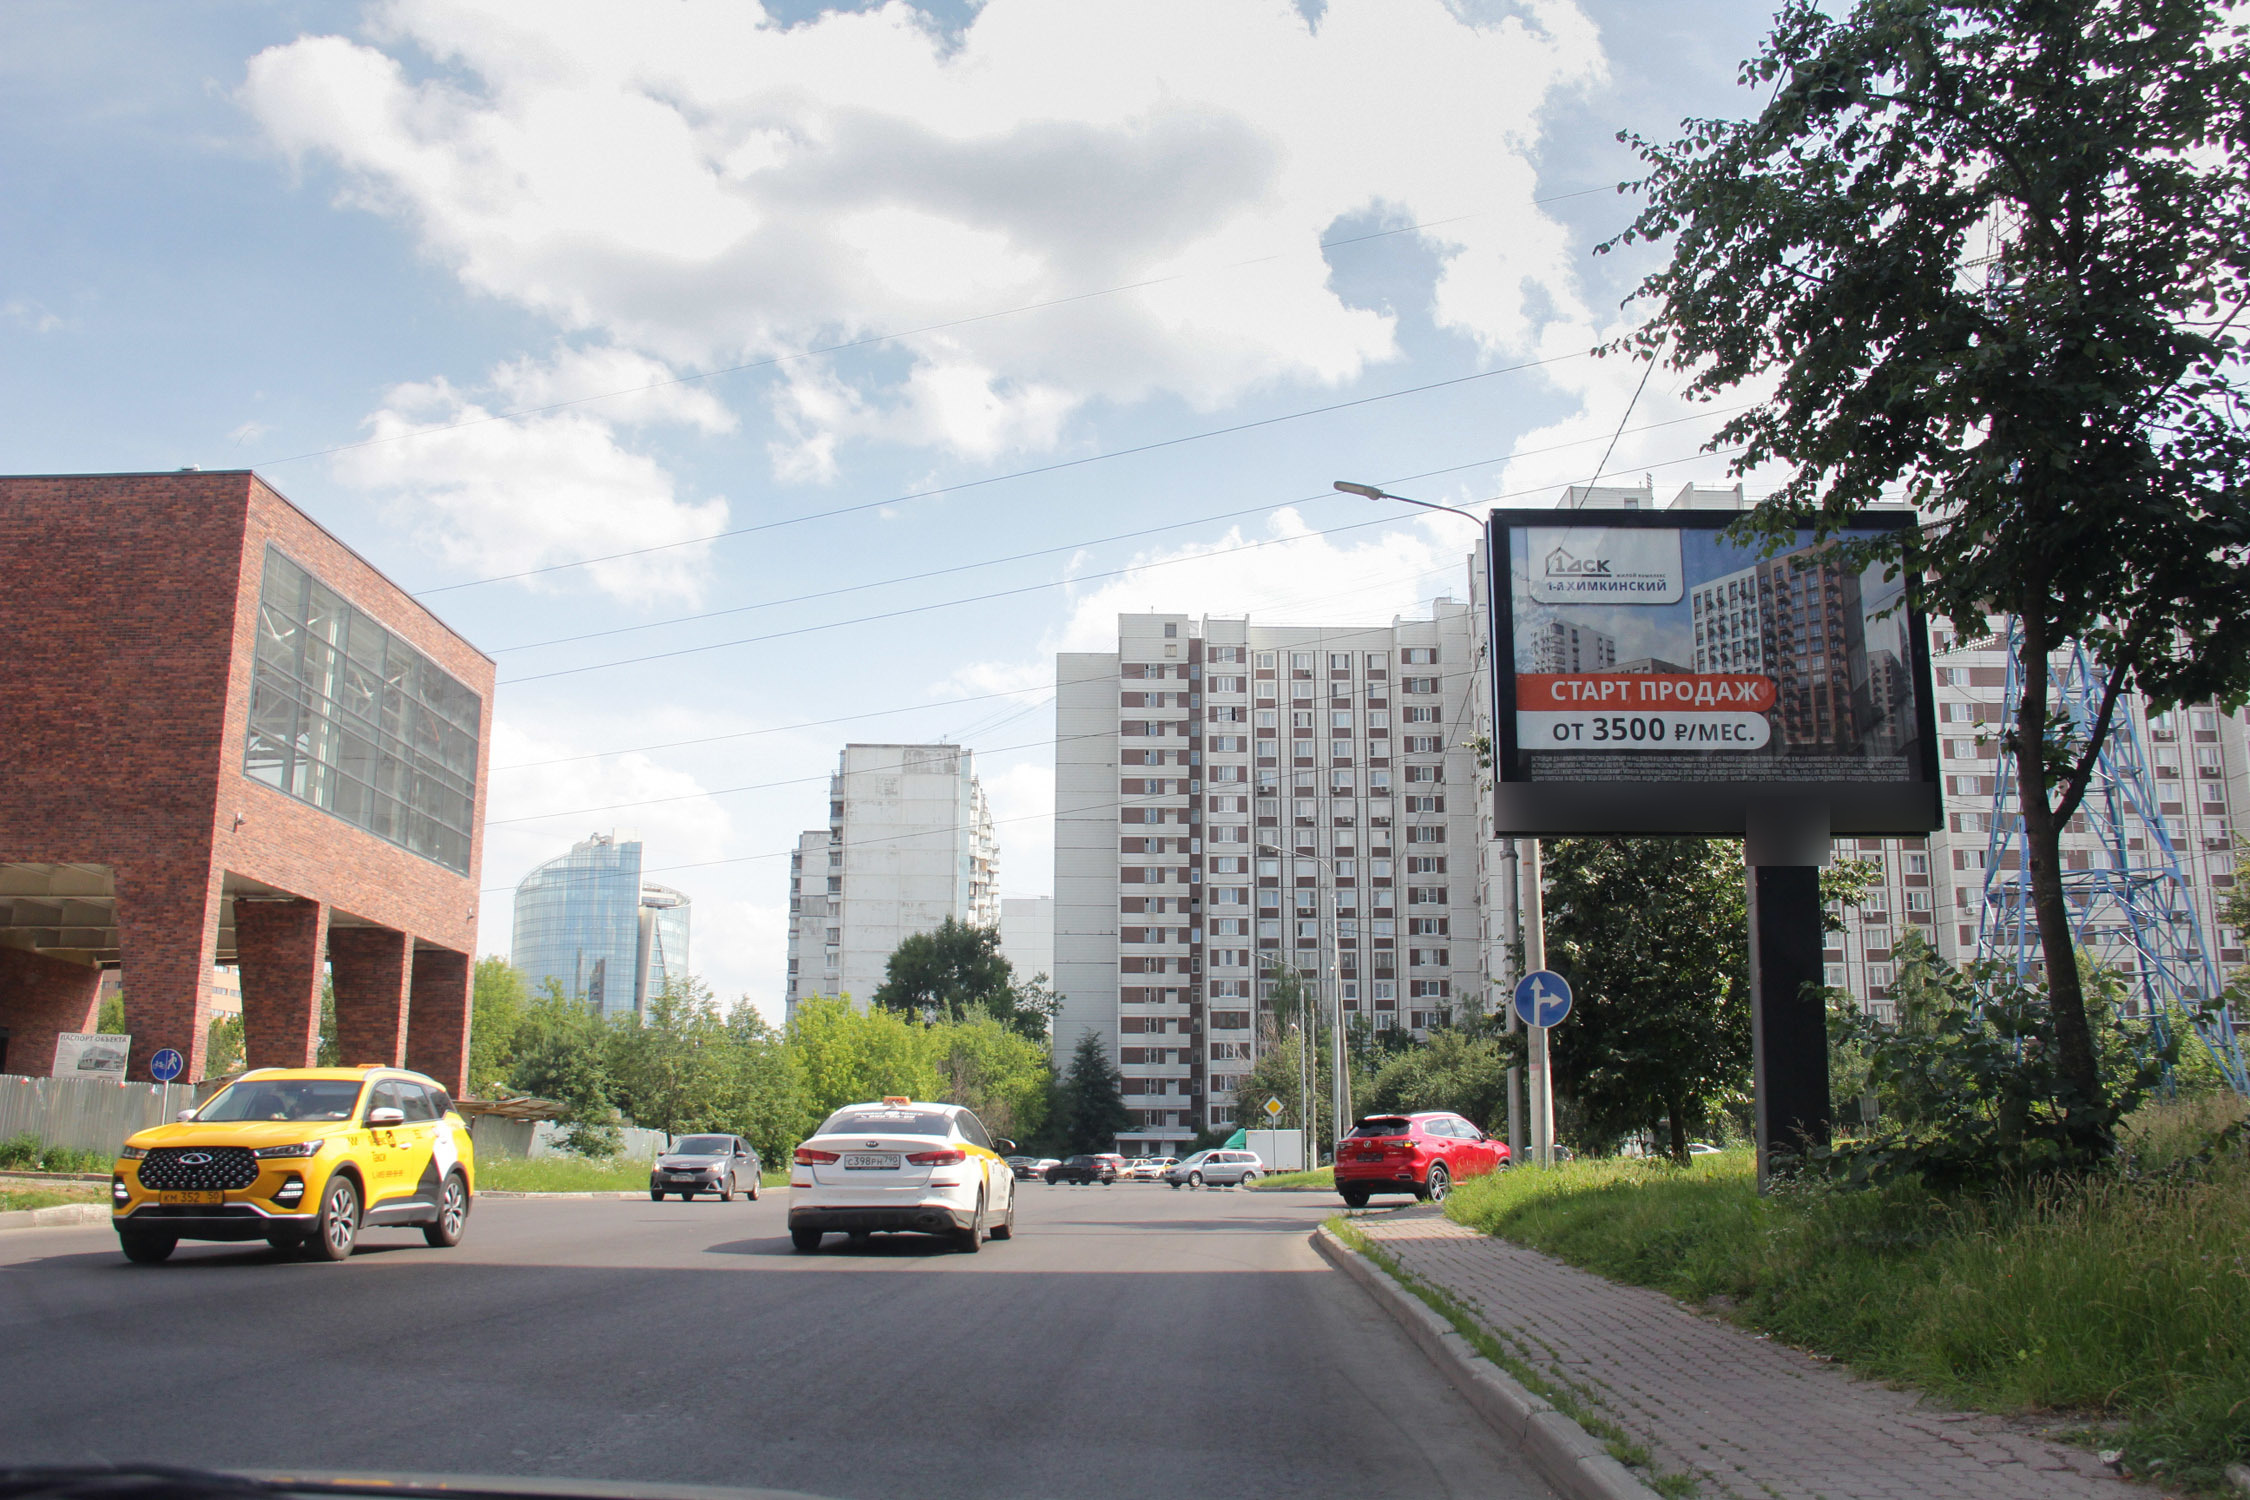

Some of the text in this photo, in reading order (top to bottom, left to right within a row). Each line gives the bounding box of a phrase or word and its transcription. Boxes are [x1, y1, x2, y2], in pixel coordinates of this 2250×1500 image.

[1567, 579, 1667, 592] ХИМКИНСКИЙ
[1551, 680, 1760, 706] СТАРТ ПРОДАЖ
[1553, 723, 1584, 741] ОТ
[1592, 717, 1665, 742] 3500
[60, 1034, 127, 1043] ПАСПОРТ ОБЪЕКТА
